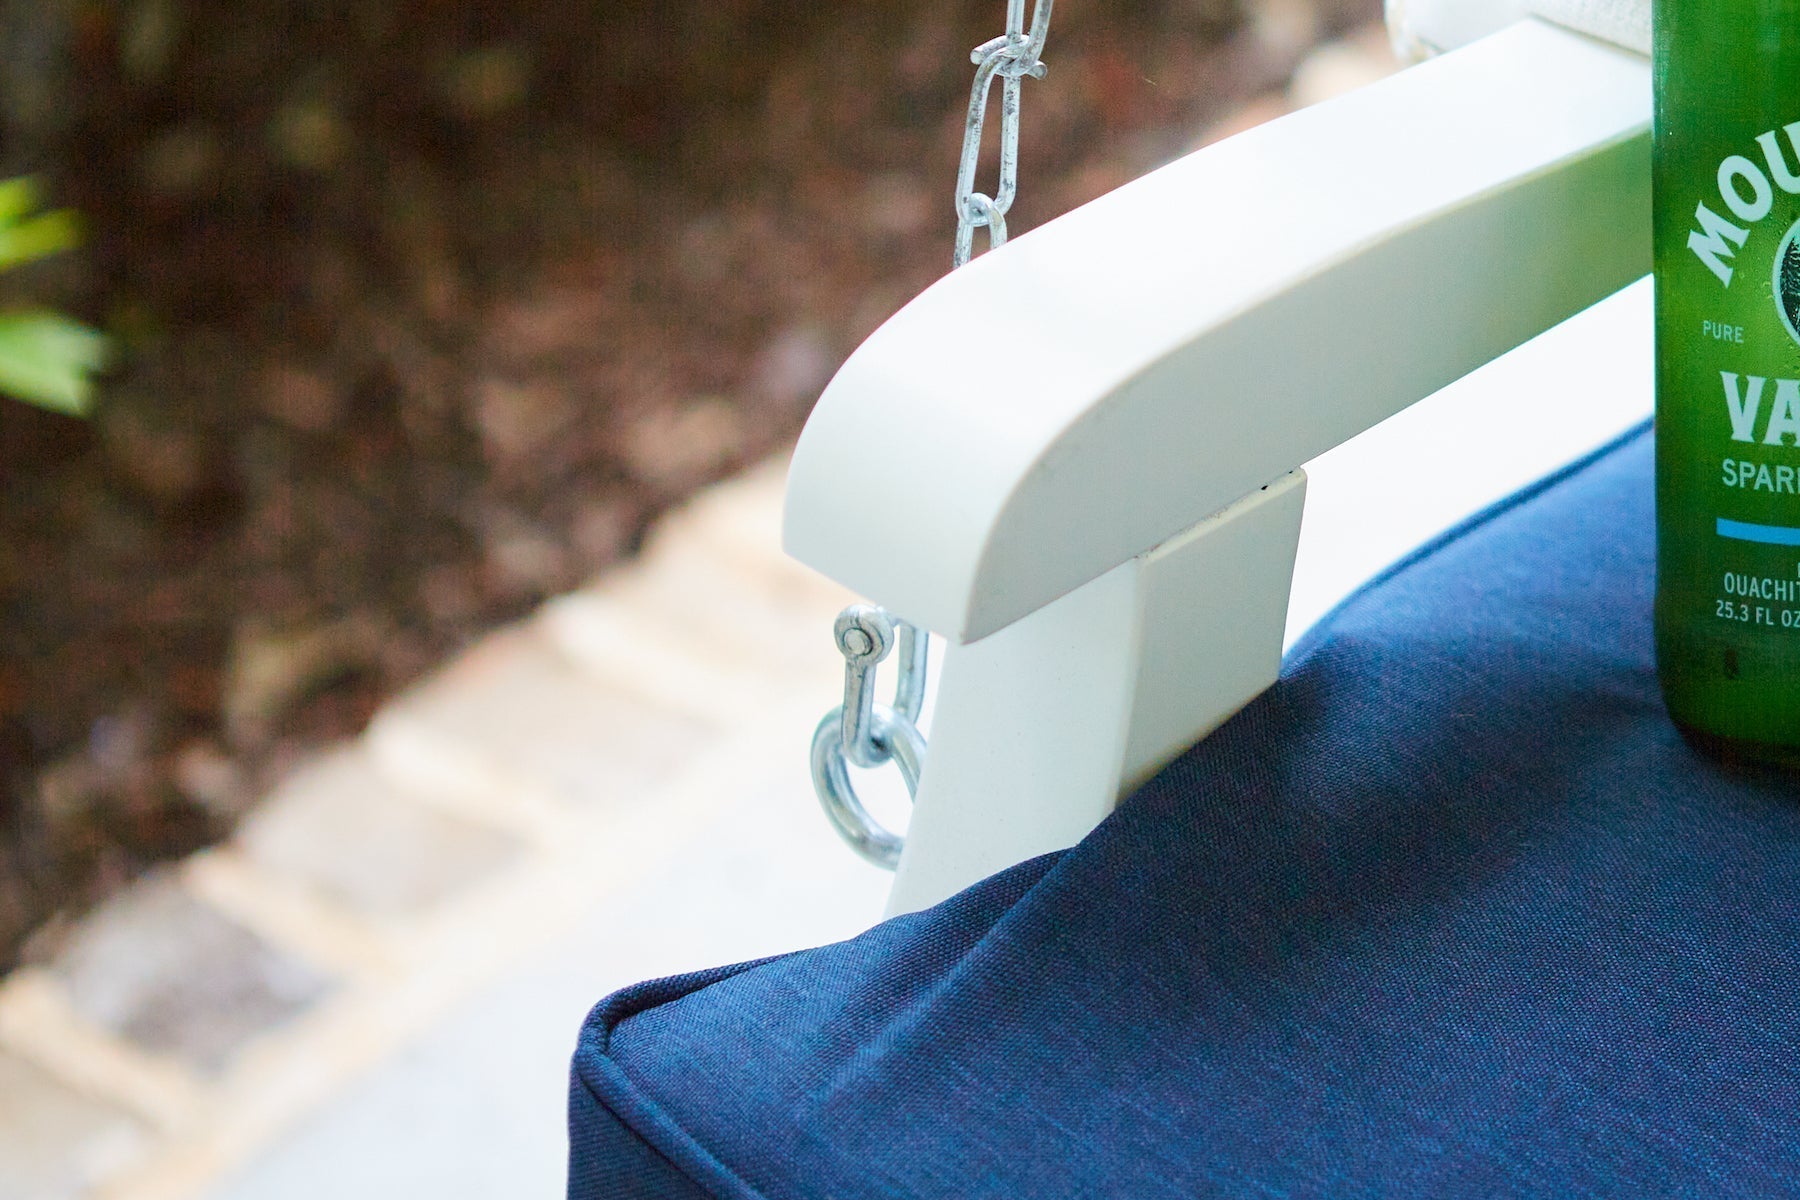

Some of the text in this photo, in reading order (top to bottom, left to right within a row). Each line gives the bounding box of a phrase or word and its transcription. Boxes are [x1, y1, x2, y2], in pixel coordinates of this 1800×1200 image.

[1702, 320, 1744, 343] PURE
[1715, 600, 1750, 622] 25.3
[1755, 607, 1775, 626] FL
